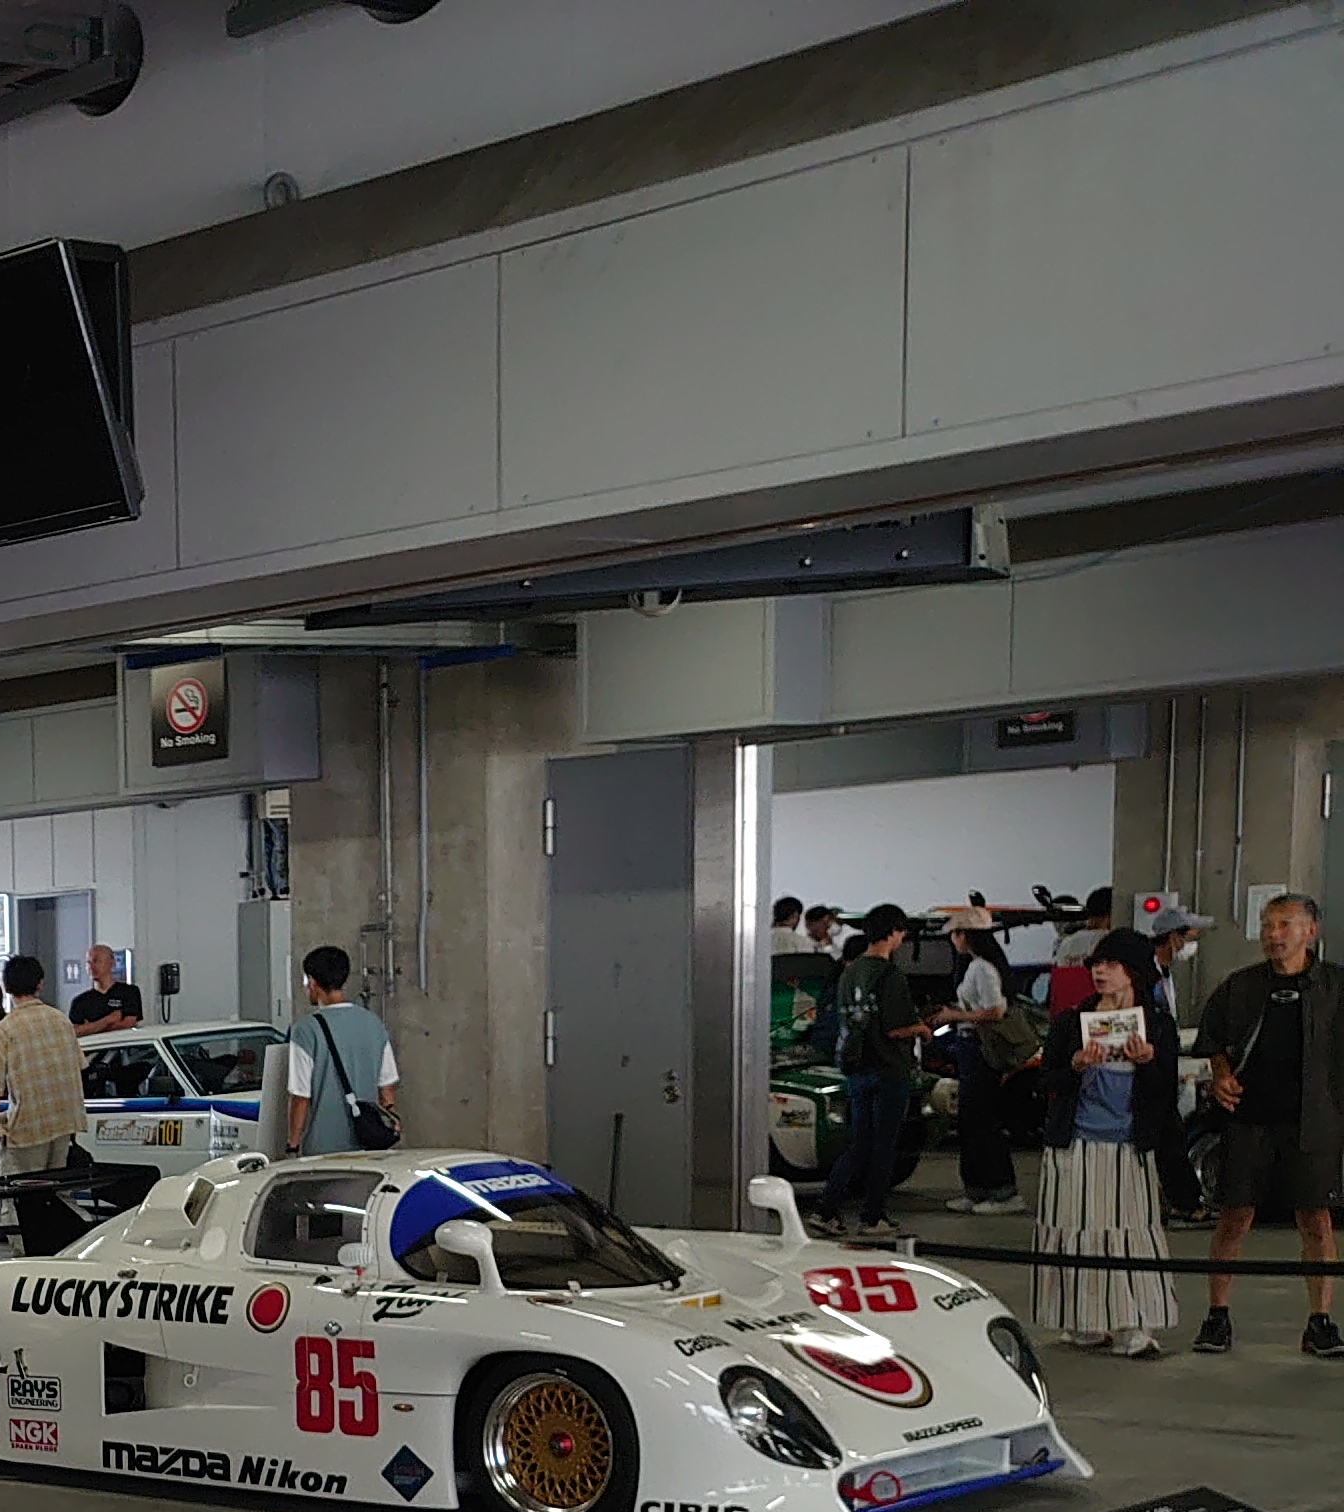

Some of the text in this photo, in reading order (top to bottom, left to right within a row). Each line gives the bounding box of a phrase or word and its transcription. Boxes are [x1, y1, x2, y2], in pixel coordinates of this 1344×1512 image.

[160, 732, 216, 748] No Smoking
[160, 1120, 182, 1145] 101
[461, 1173, 551, 1194] mazda
[11, 1276, 235, 1325] LUCKY STRIKE
[803, 1264, 919, 1313] 85
[723, 1311, 817, 1332] Nikon
[10, 1379, 59, 1399] RAYS
[294, 1336, 380, 1437] 85
[11, 1397, 59, 1408] ENGINEERING
[10, 1420, 58, 1445] NGK
[102, 1440, 232, 1482] mazda
[238, 1456, 348, 1496] Nikon
